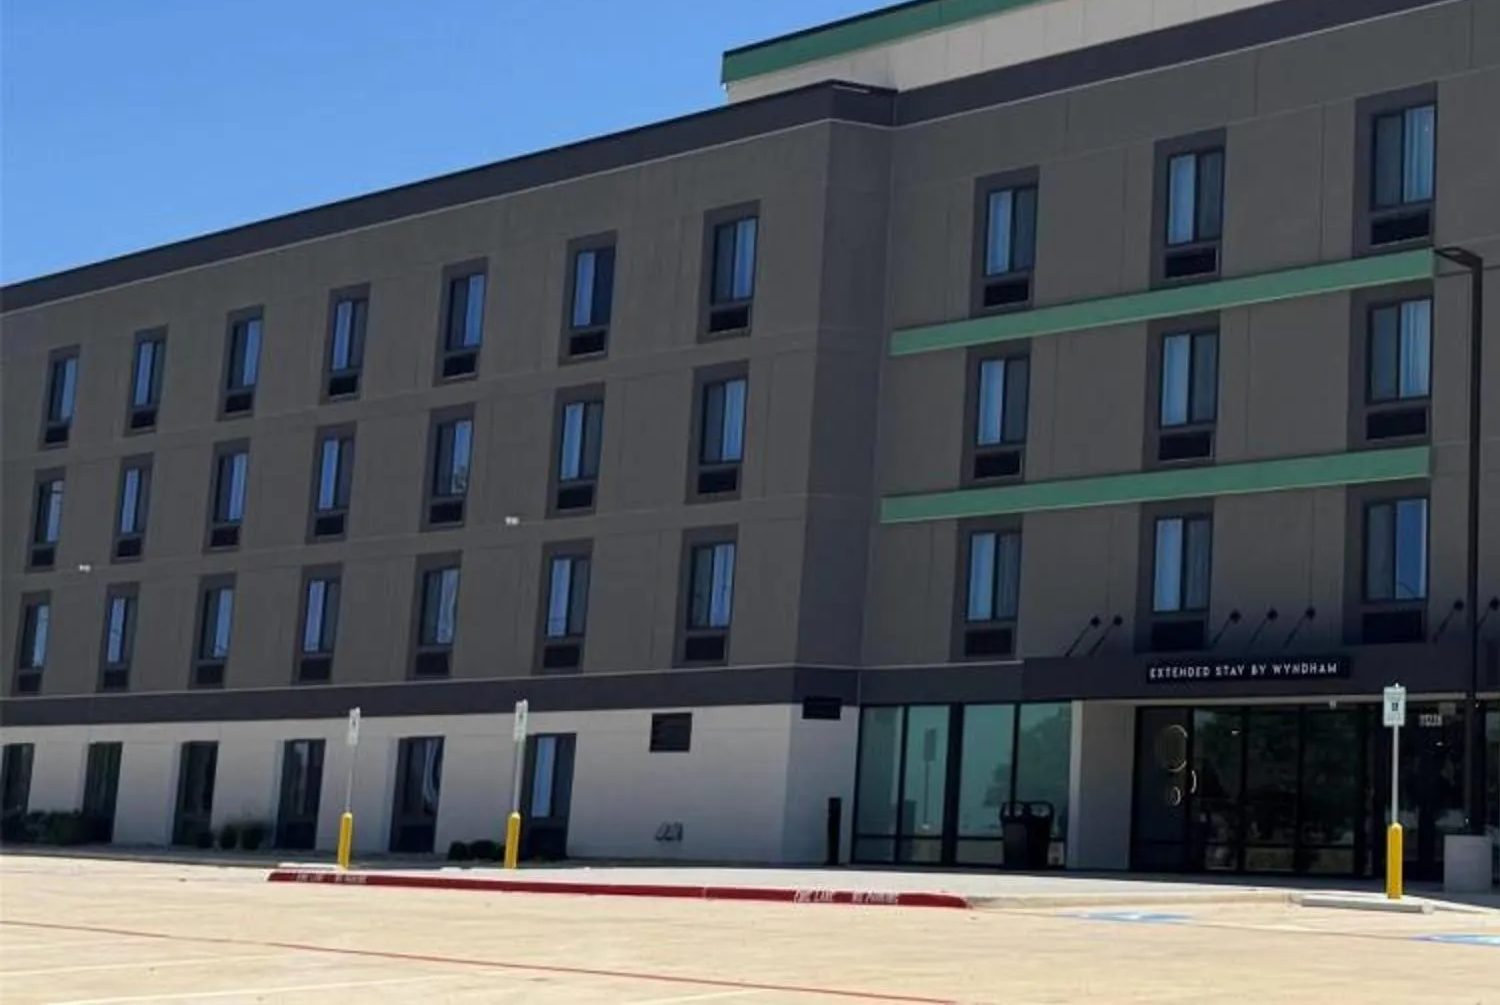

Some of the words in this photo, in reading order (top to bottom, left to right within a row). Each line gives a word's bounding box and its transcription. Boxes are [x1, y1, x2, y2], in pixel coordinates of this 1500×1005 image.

[1149, 666, 1211, 679] EXTENDED
[1215, 664, 1245, 676] STAY
[1250, 663, 1267, 676] BY
[1272, 662, 1337, 675] WYNDHAM
